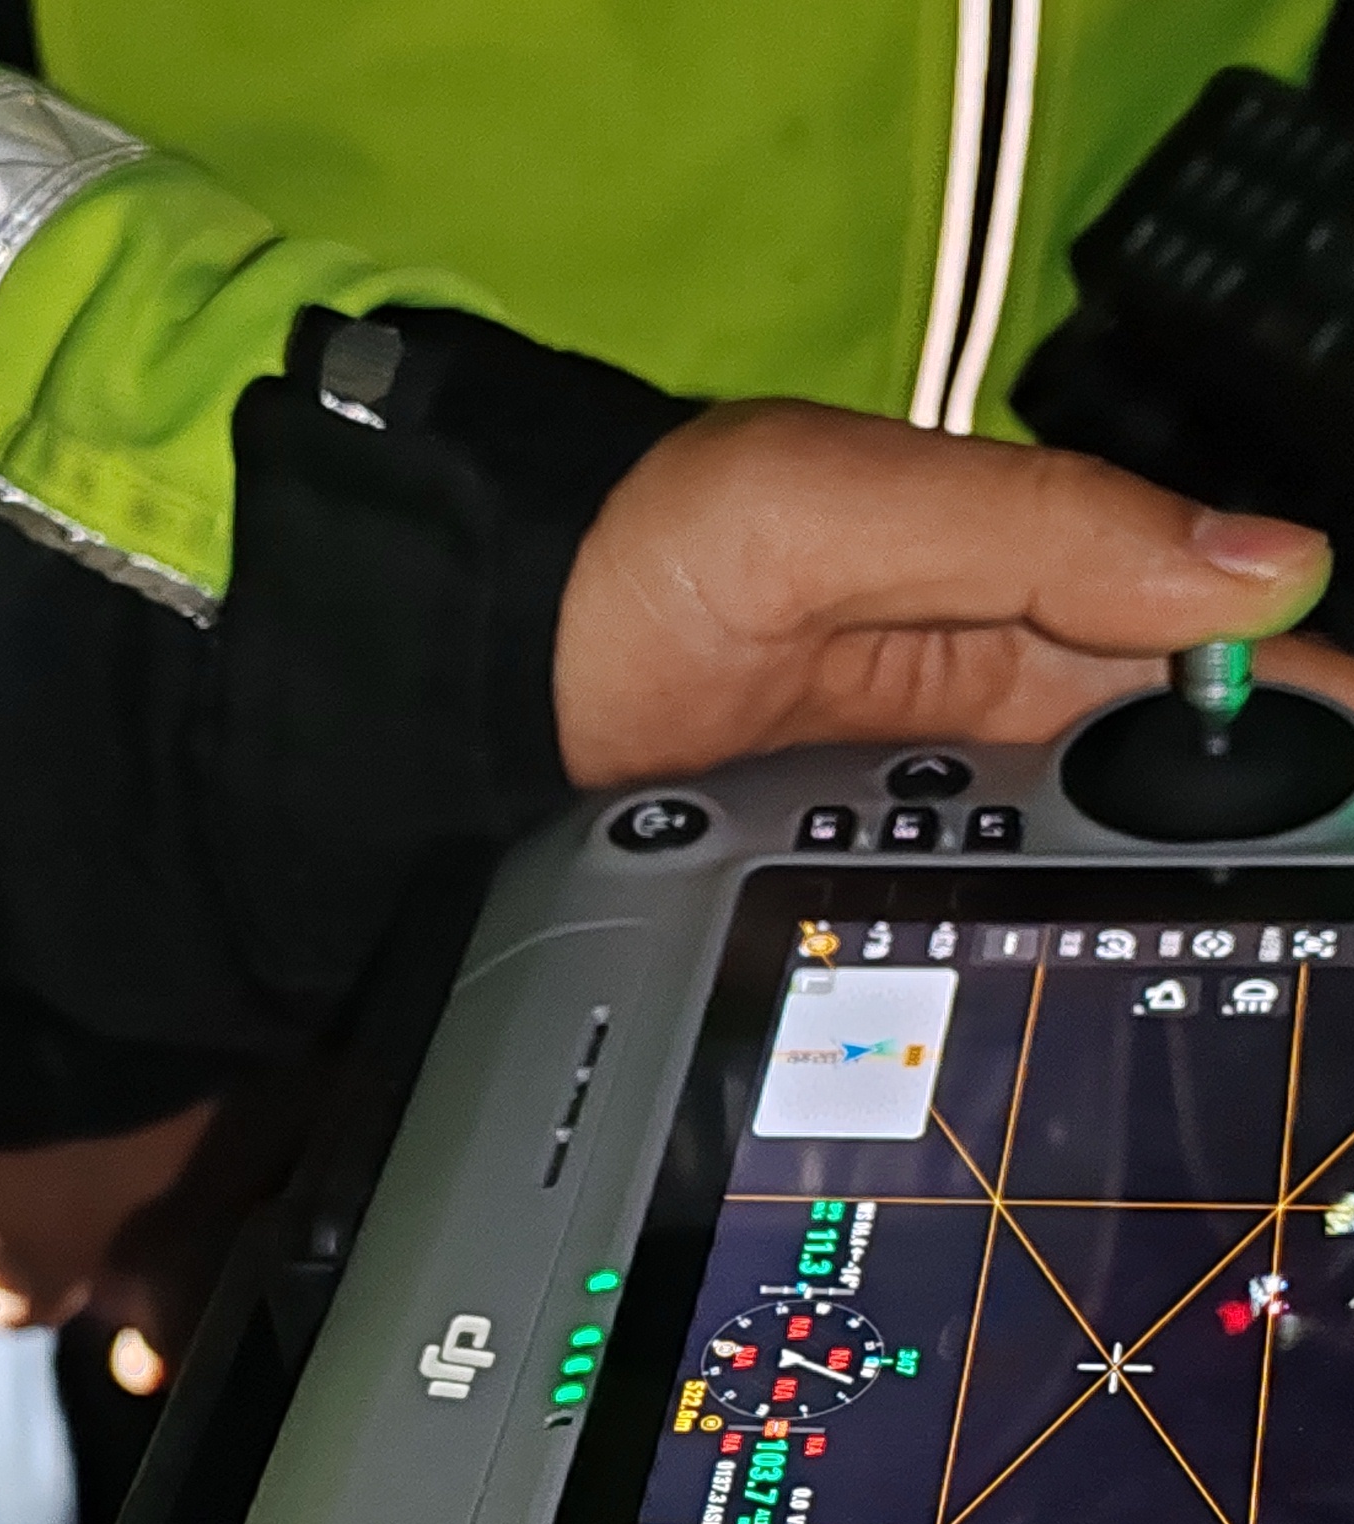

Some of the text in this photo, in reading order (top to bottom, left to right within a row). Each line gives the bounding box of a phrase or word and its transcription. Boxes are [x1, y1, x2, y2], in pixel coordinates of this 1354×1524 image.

[799, 1229, 838, 1275] 11.3
[787, 1316, 813, 1340] NA
[772, 1378, 797, 1401] NA
[745, 1440, 788, 1504] 103.7
